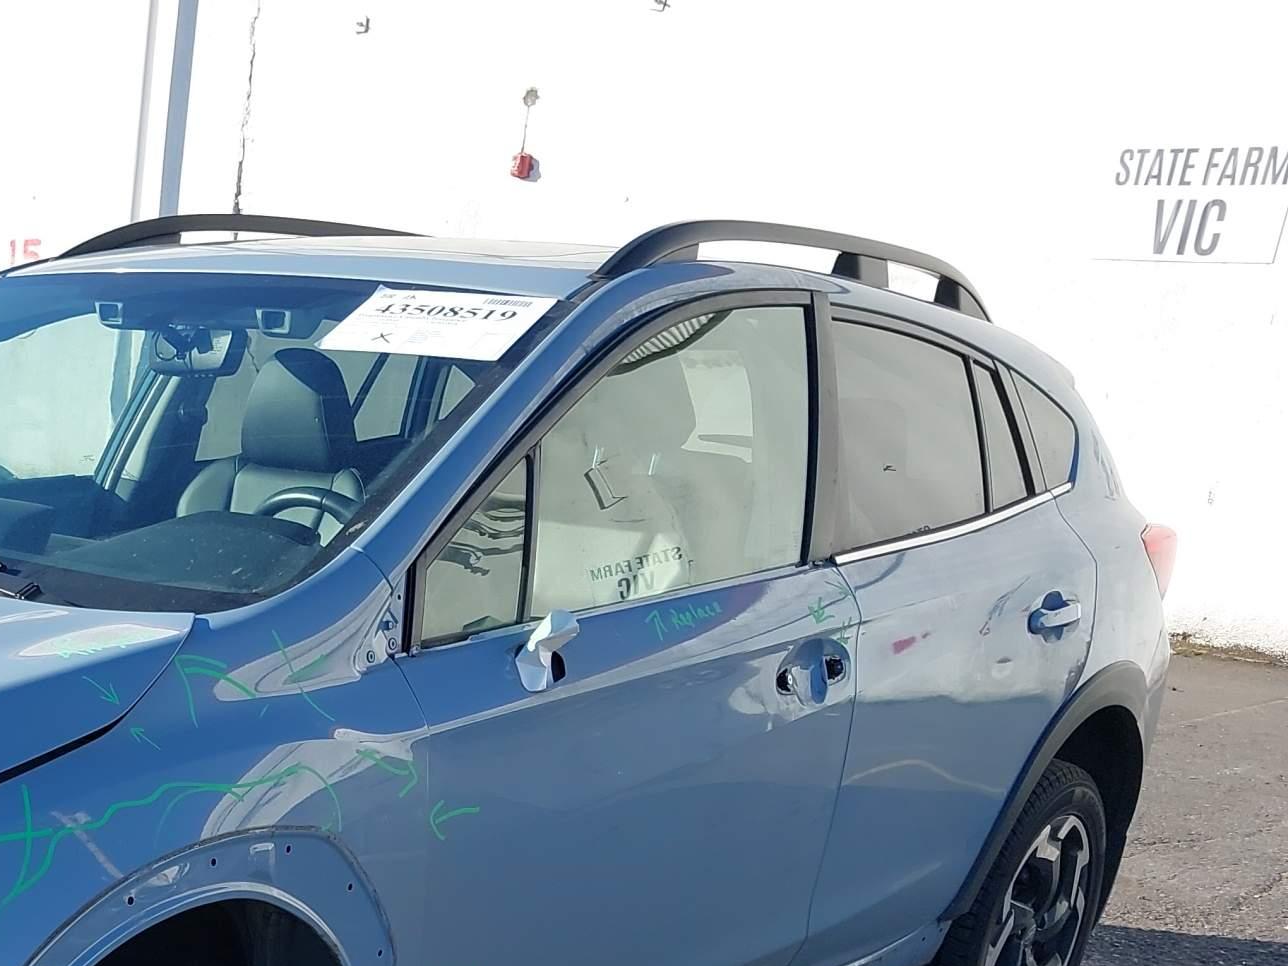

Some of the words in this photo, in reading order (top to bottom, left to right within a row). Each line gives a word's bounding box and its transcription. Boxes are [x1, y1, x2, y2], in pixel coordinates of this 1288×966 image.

[1114, 147, 1201, 187] STATE
[1201, 146, 1288, 187] FARM
[1152, 198, 1227, 256] VIC
[9, 238, 42, 265] 15
[375, 302, 517, 321] 43508519
